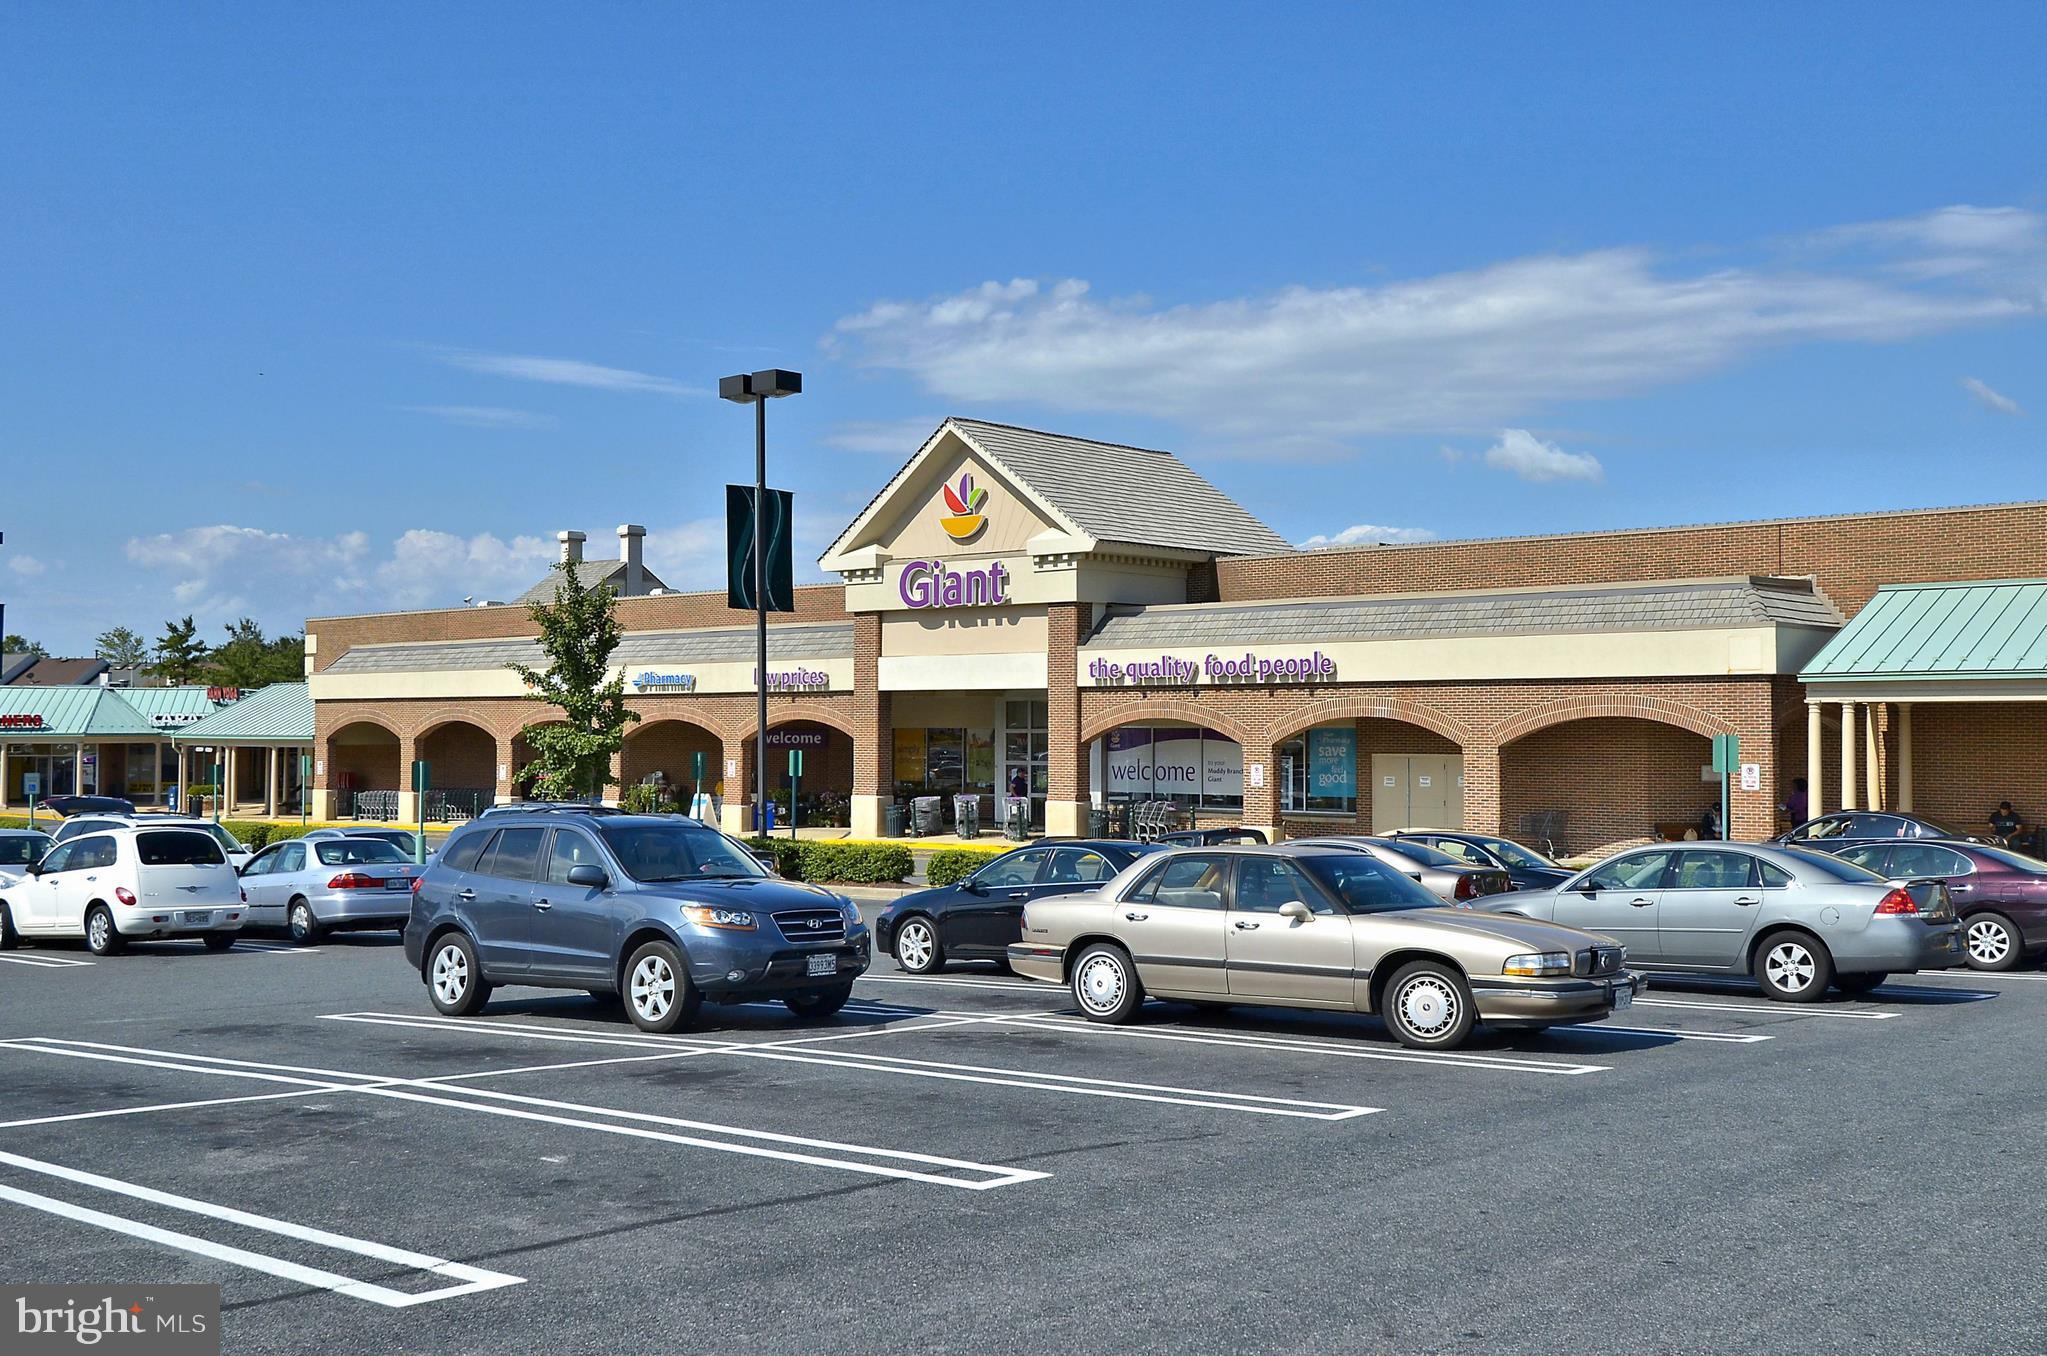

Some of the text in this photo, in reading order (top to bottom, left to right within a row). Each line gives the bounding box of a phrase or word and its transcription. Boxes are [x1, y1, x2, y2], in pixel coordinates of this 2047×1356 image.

[899, 560, 1005, 608] Giant
[1089, 651, 1334, 684] the quality food people
[644, 671, 693, 688] Pharmacy
[754, 667, 825, 689] lw prices
[0, 714, 43, 727] NERS
[1318, 746, 1347, 757] save
[1111, 758, 1196, 782] welcome
[1318, 770, 1347, 787] good
